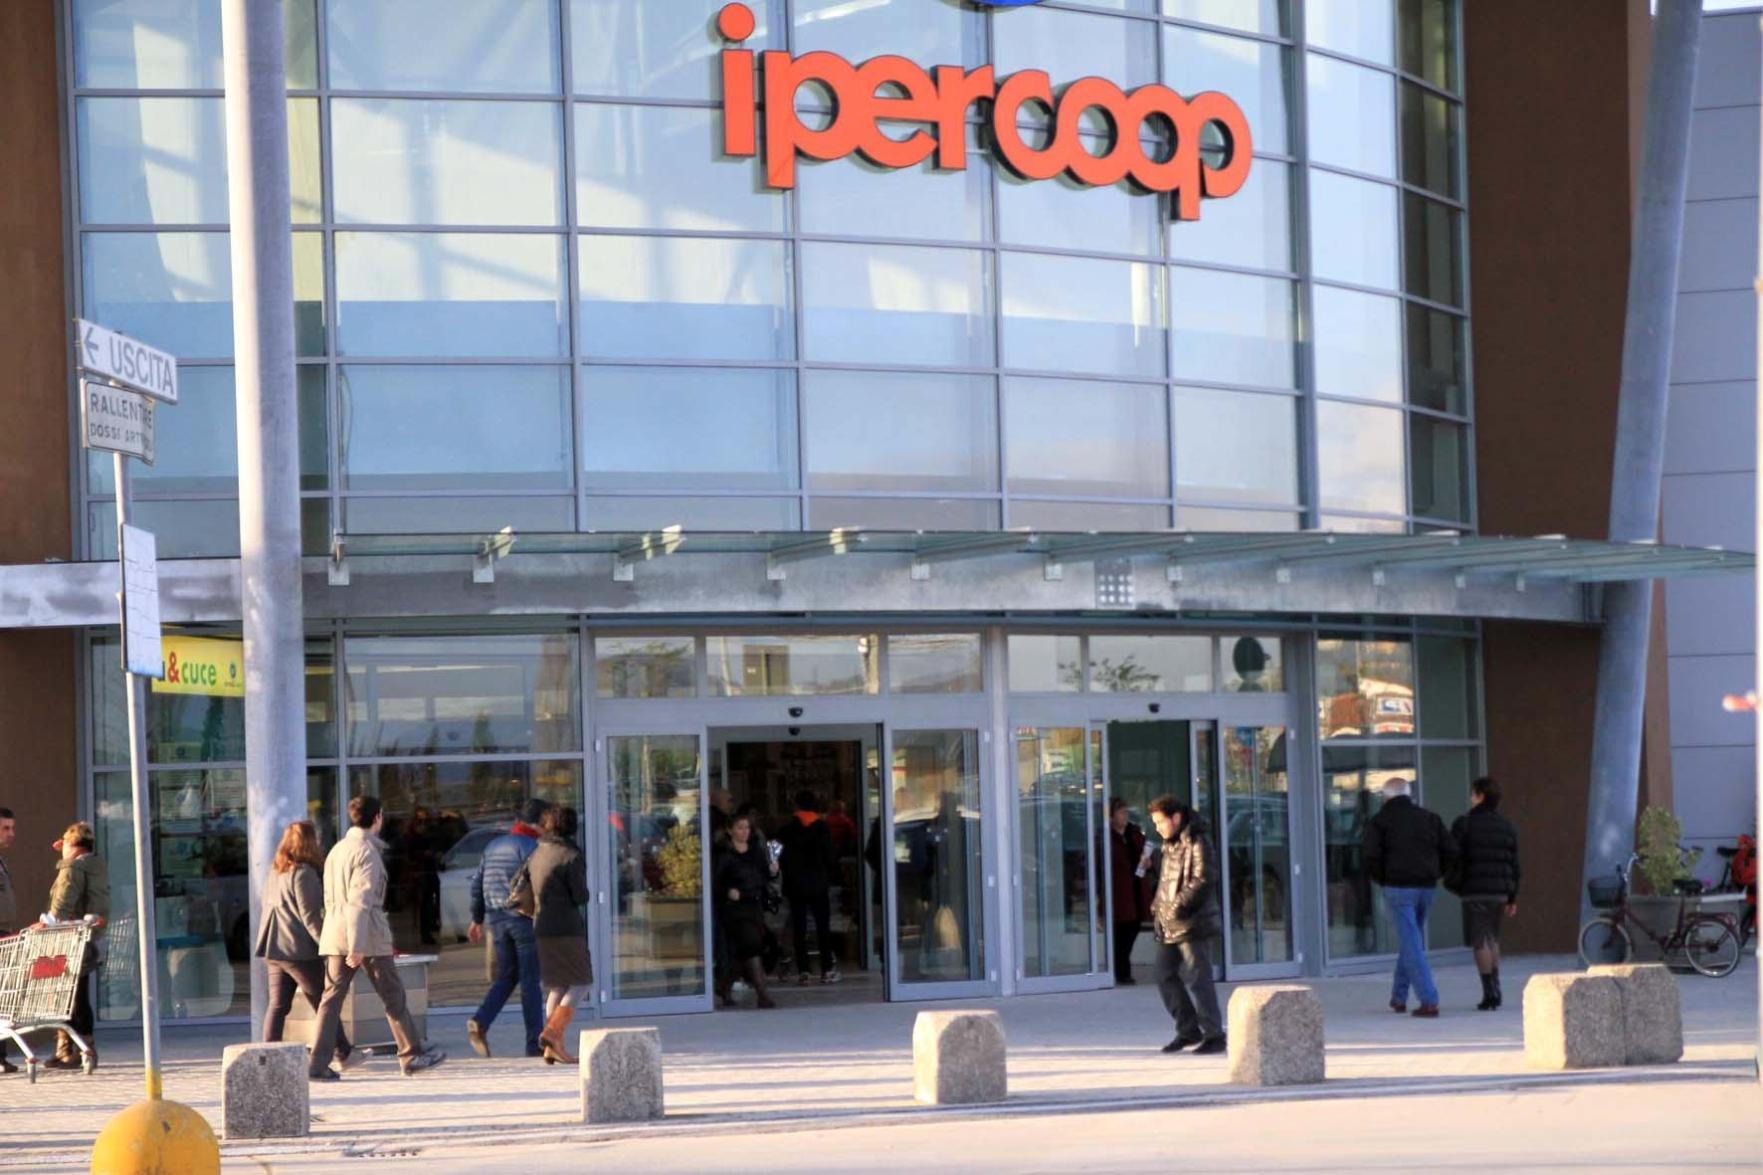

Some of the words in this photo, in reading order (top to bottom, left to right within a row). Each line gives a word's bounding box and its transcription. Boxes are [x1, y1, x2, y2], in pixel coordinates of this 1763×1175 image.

[719, 3, 1252, 221] ipercoop
[109, 336, 175, 396] USCITA
[90, 422, 121, 441] DOSSI
